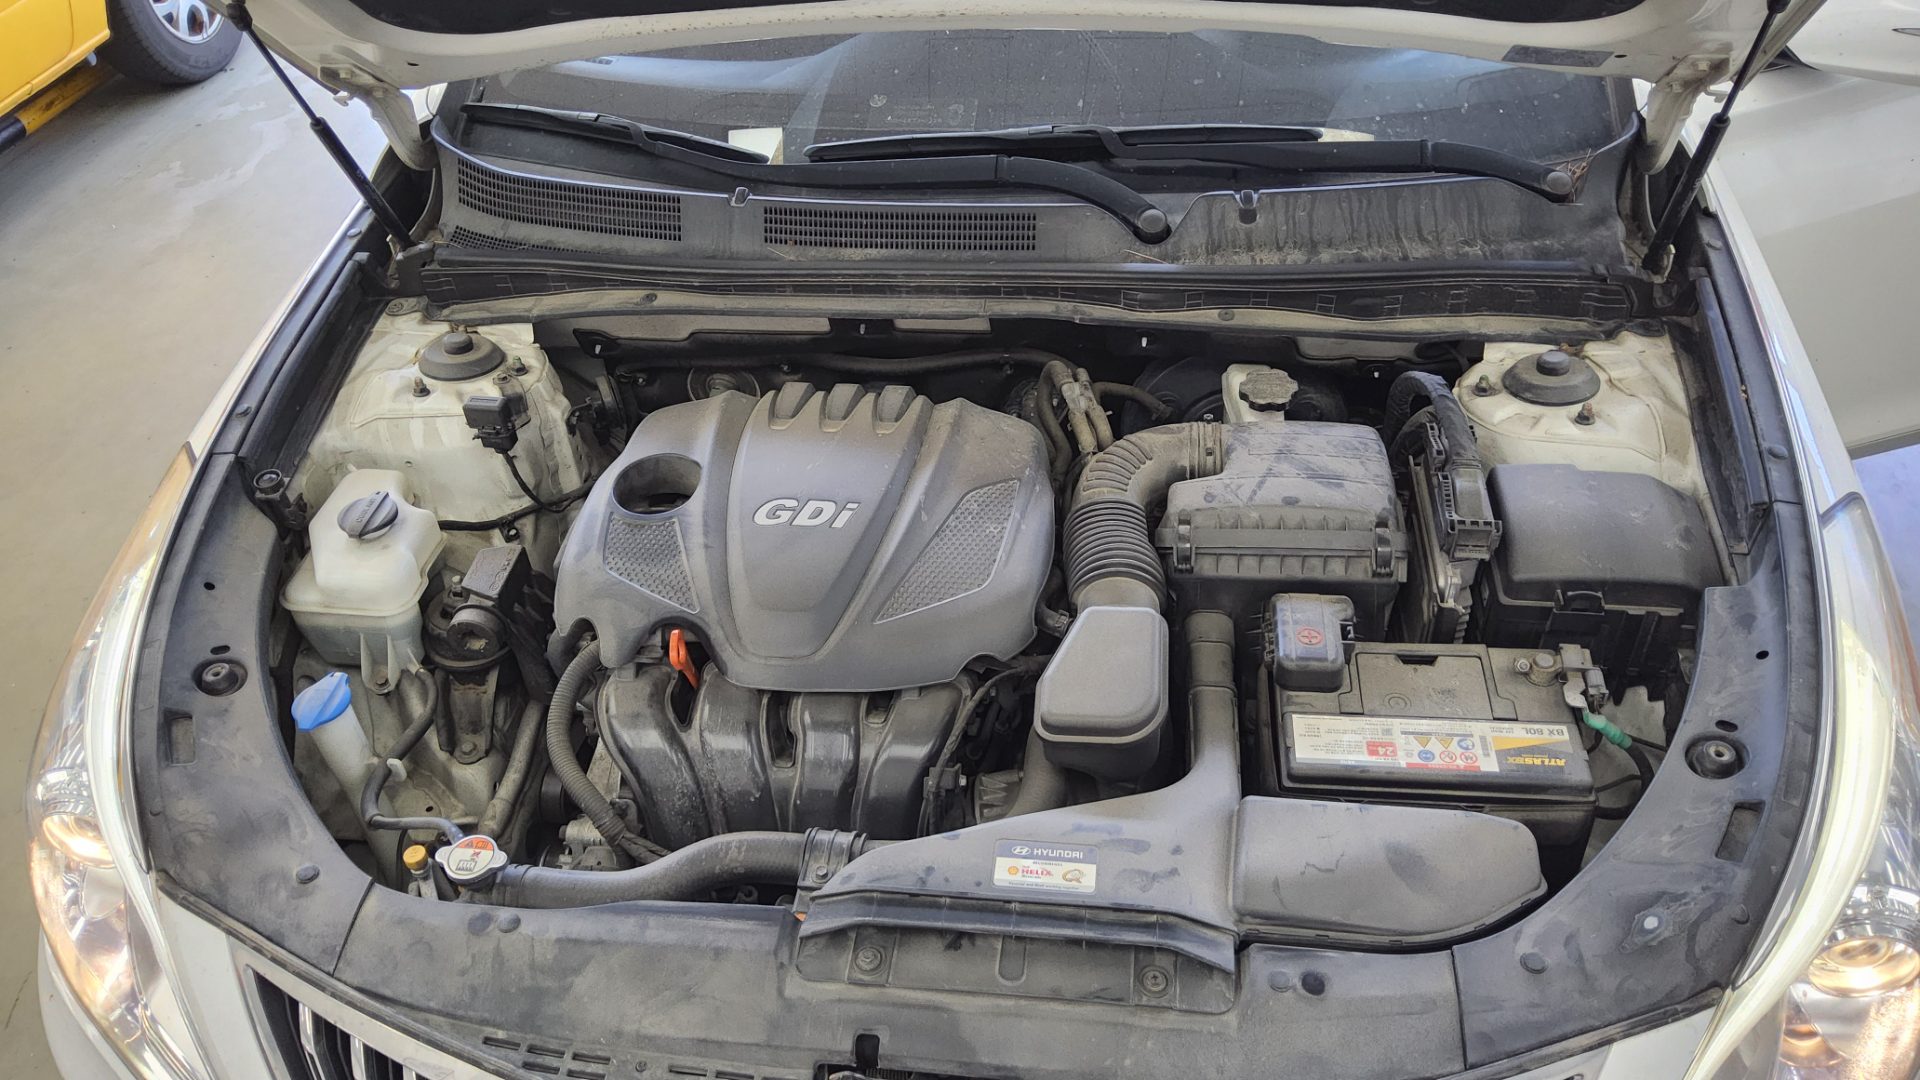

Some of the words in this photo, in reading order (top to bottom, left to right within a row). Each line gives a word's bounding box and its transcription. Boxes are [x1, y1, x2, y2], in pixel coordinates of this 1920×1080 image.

[752, 498, 860, 528] GDi
[1548, 728, 1565, 736] BX
[1377, 746, 1395, 757] 24
[1033, 848, 1083, 859] HYUNDAI
[1021, 868, 1053, 877] HELIX
